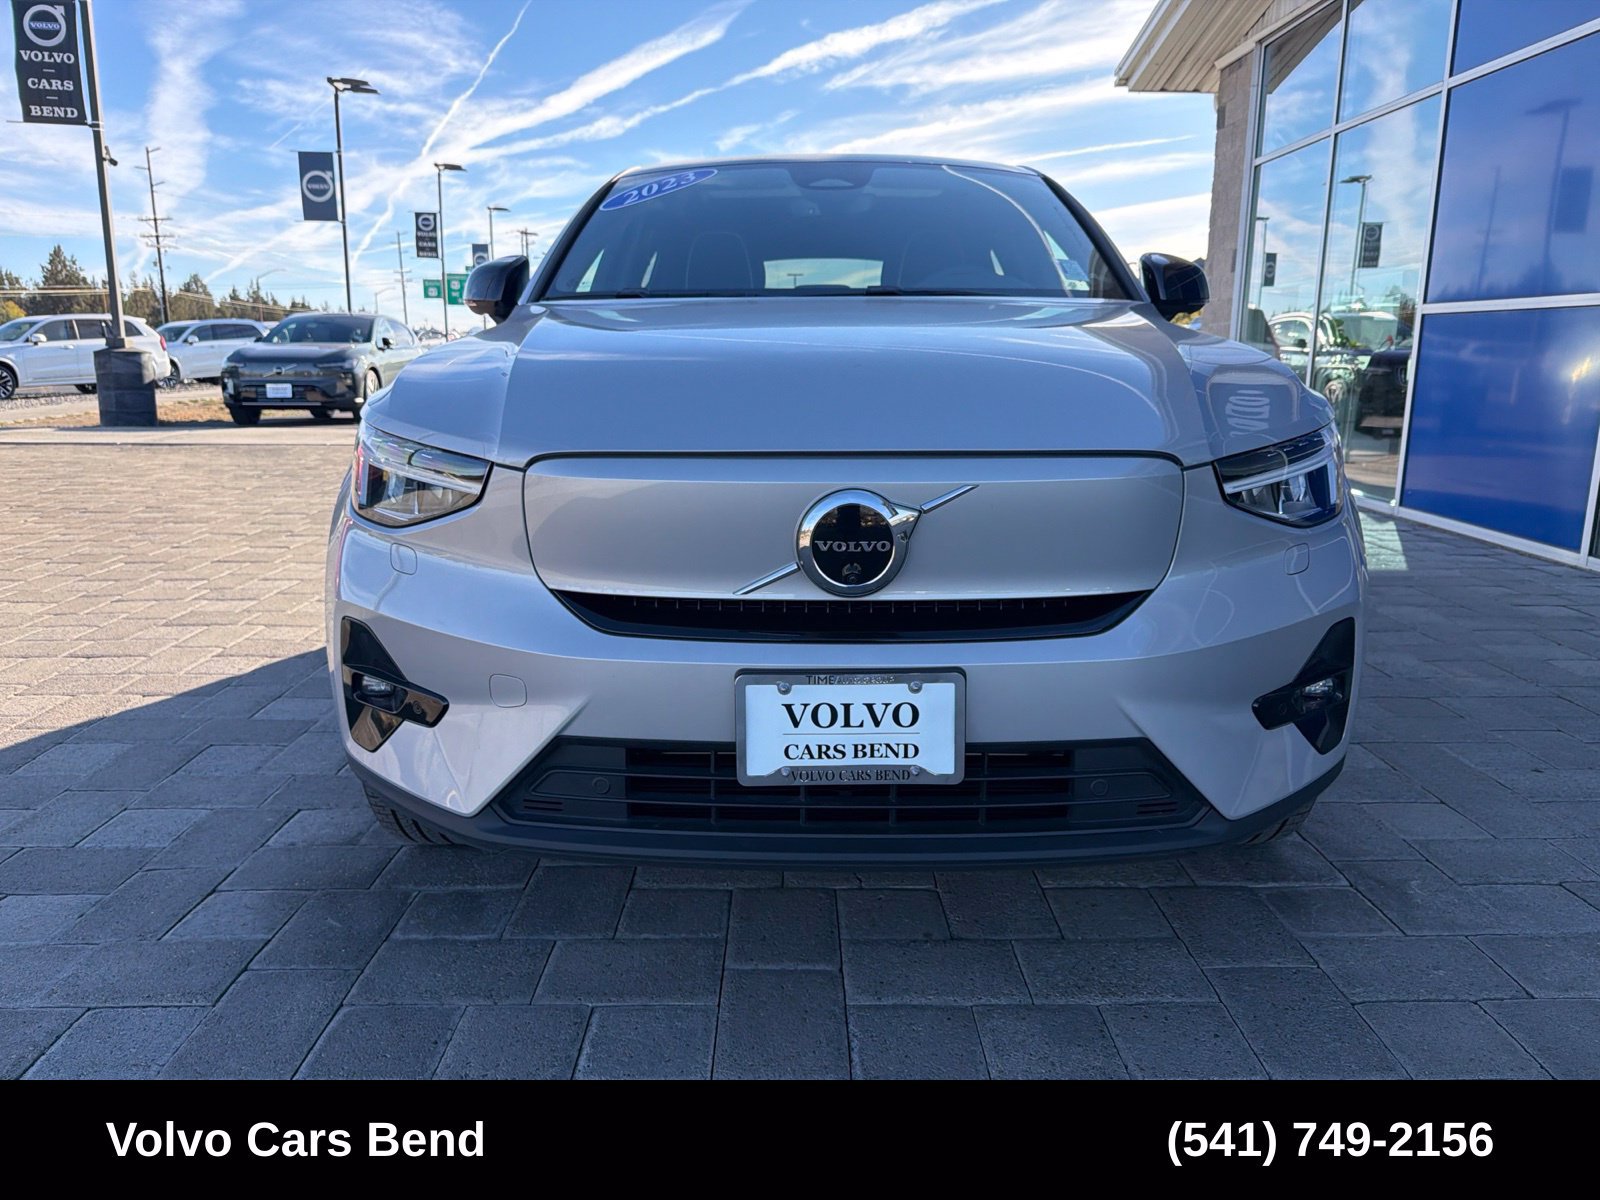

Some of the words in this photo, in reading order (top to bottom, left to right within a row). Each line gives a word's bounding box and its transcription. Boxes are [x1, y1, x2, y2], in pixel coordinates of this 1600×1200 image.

[30, 22, 60, 30] VOLVO
[19, 50, 75, 64] VOLVO
[28, 78, 74, 91] CARS
[29, 105, 78, 118] BEND
[623, 172, 697, 206] 2023
[815, 541, 891, 552] VOLVO
[806, 674, 834, 685] TIME
[782, 702, 920, 728] VOLVO
[784, 743, 847, 760] CARS
[851, 743, 920, 759] BEND
[791, 770, 835, 782] VOLVO
[839, 770, 872, 781] CARS
[875, 769, 911, 780] BEND
